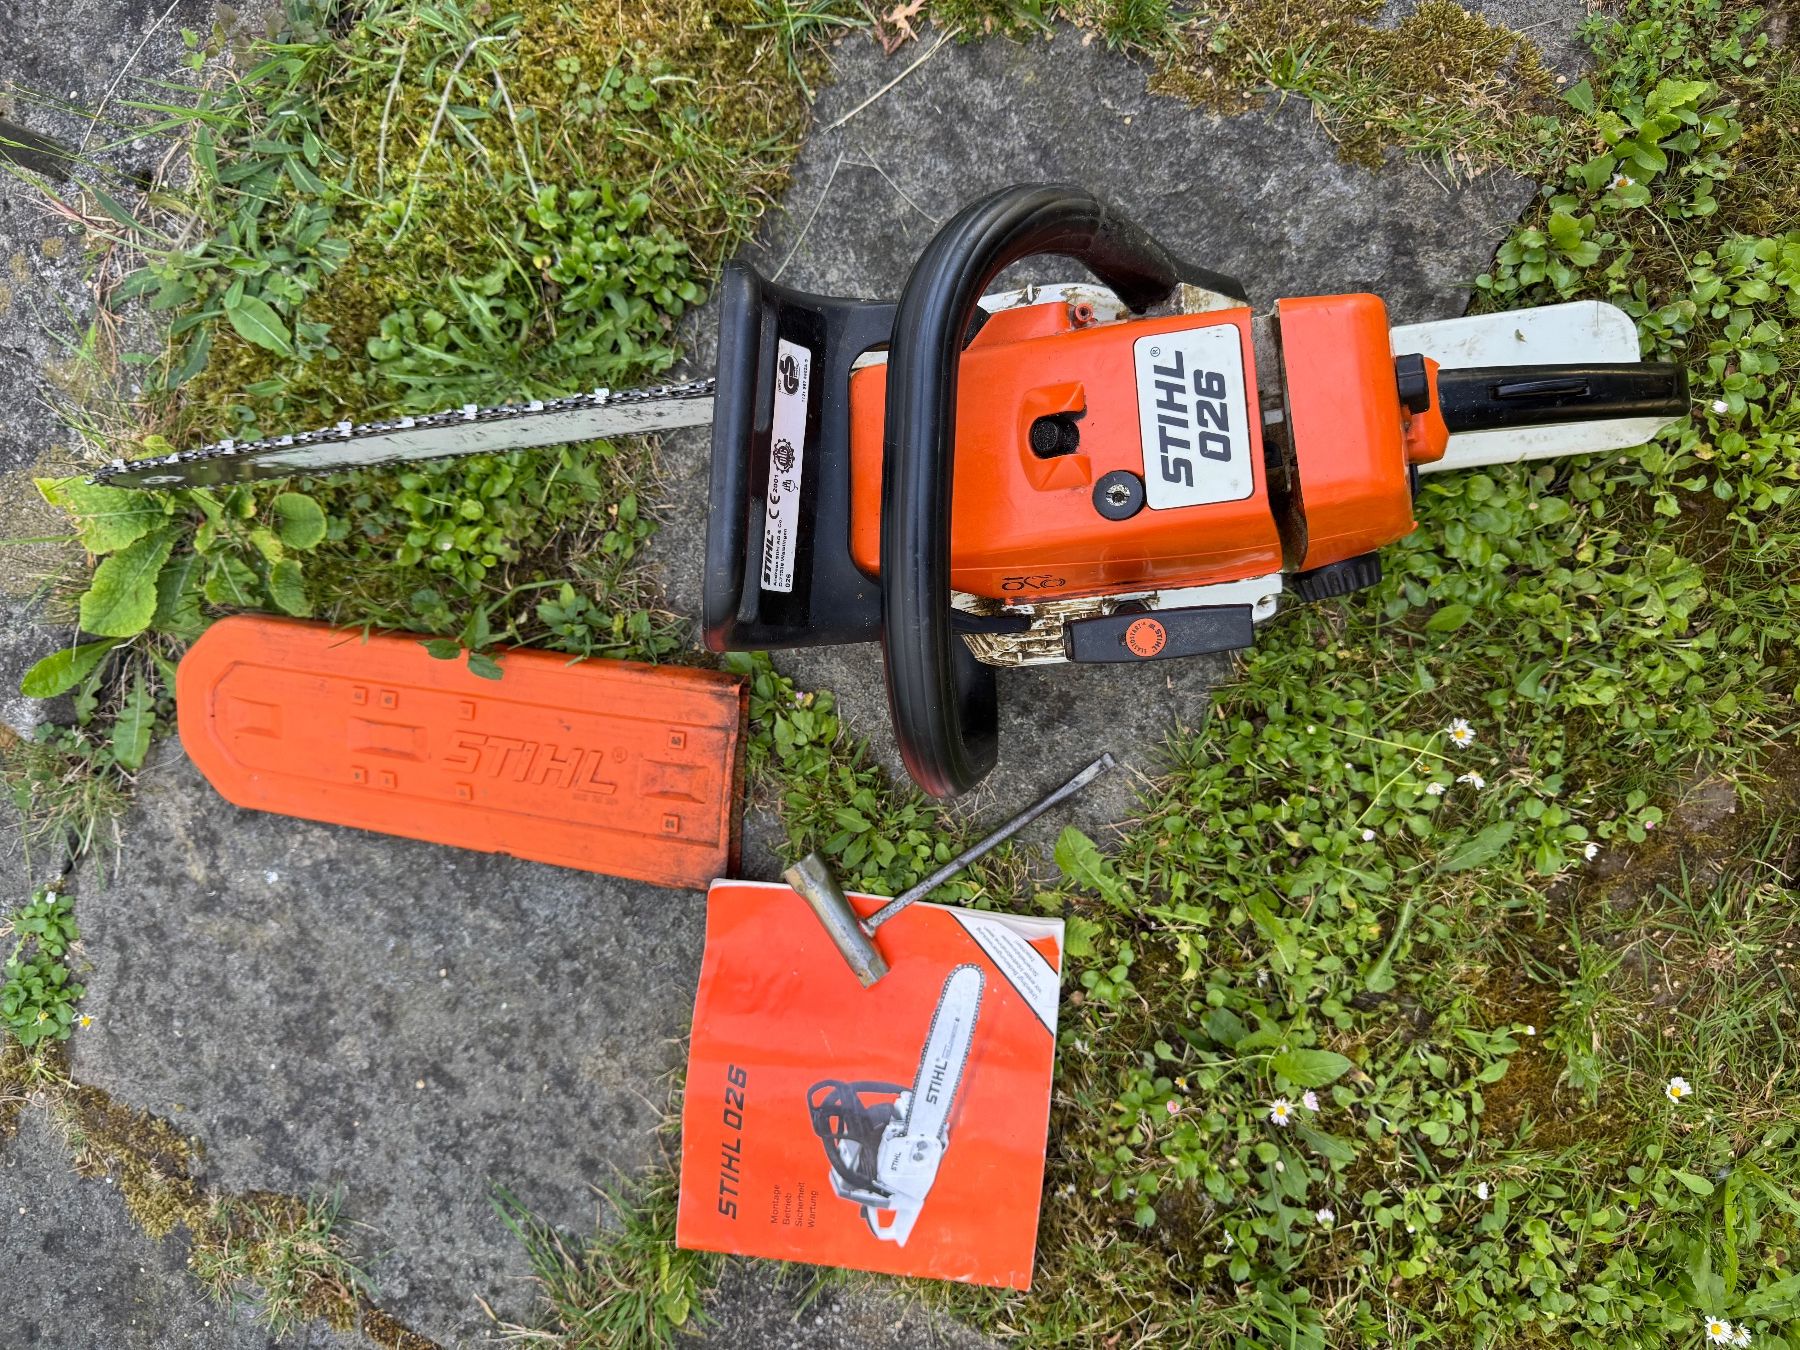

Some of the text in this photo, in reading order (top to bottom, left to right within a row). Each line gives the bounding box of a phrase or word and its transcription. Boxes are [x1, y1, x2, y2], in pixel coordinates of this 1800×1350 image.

[1153, 350, 1194, 487] STIHL
[1193, 369, 1232, 462] 026
[763, 534, 774, 586] STIHL
[1152, 628, 1163, 652] STIHL
[441, 729, 617, 795] STIHL
[926, 1060, 948, 1105] STIHL
[718, 1064, 747, 1220] STIHL 026
[890, 1151, 902, 1171] STIHL
[771, 1184, 782, 1224] Montage
[782, 1192, 792, 1225] Betrieb
[795, 1182, 806, 1227] Sicherheit
[808, 1190, 819, 1228] Wartung
